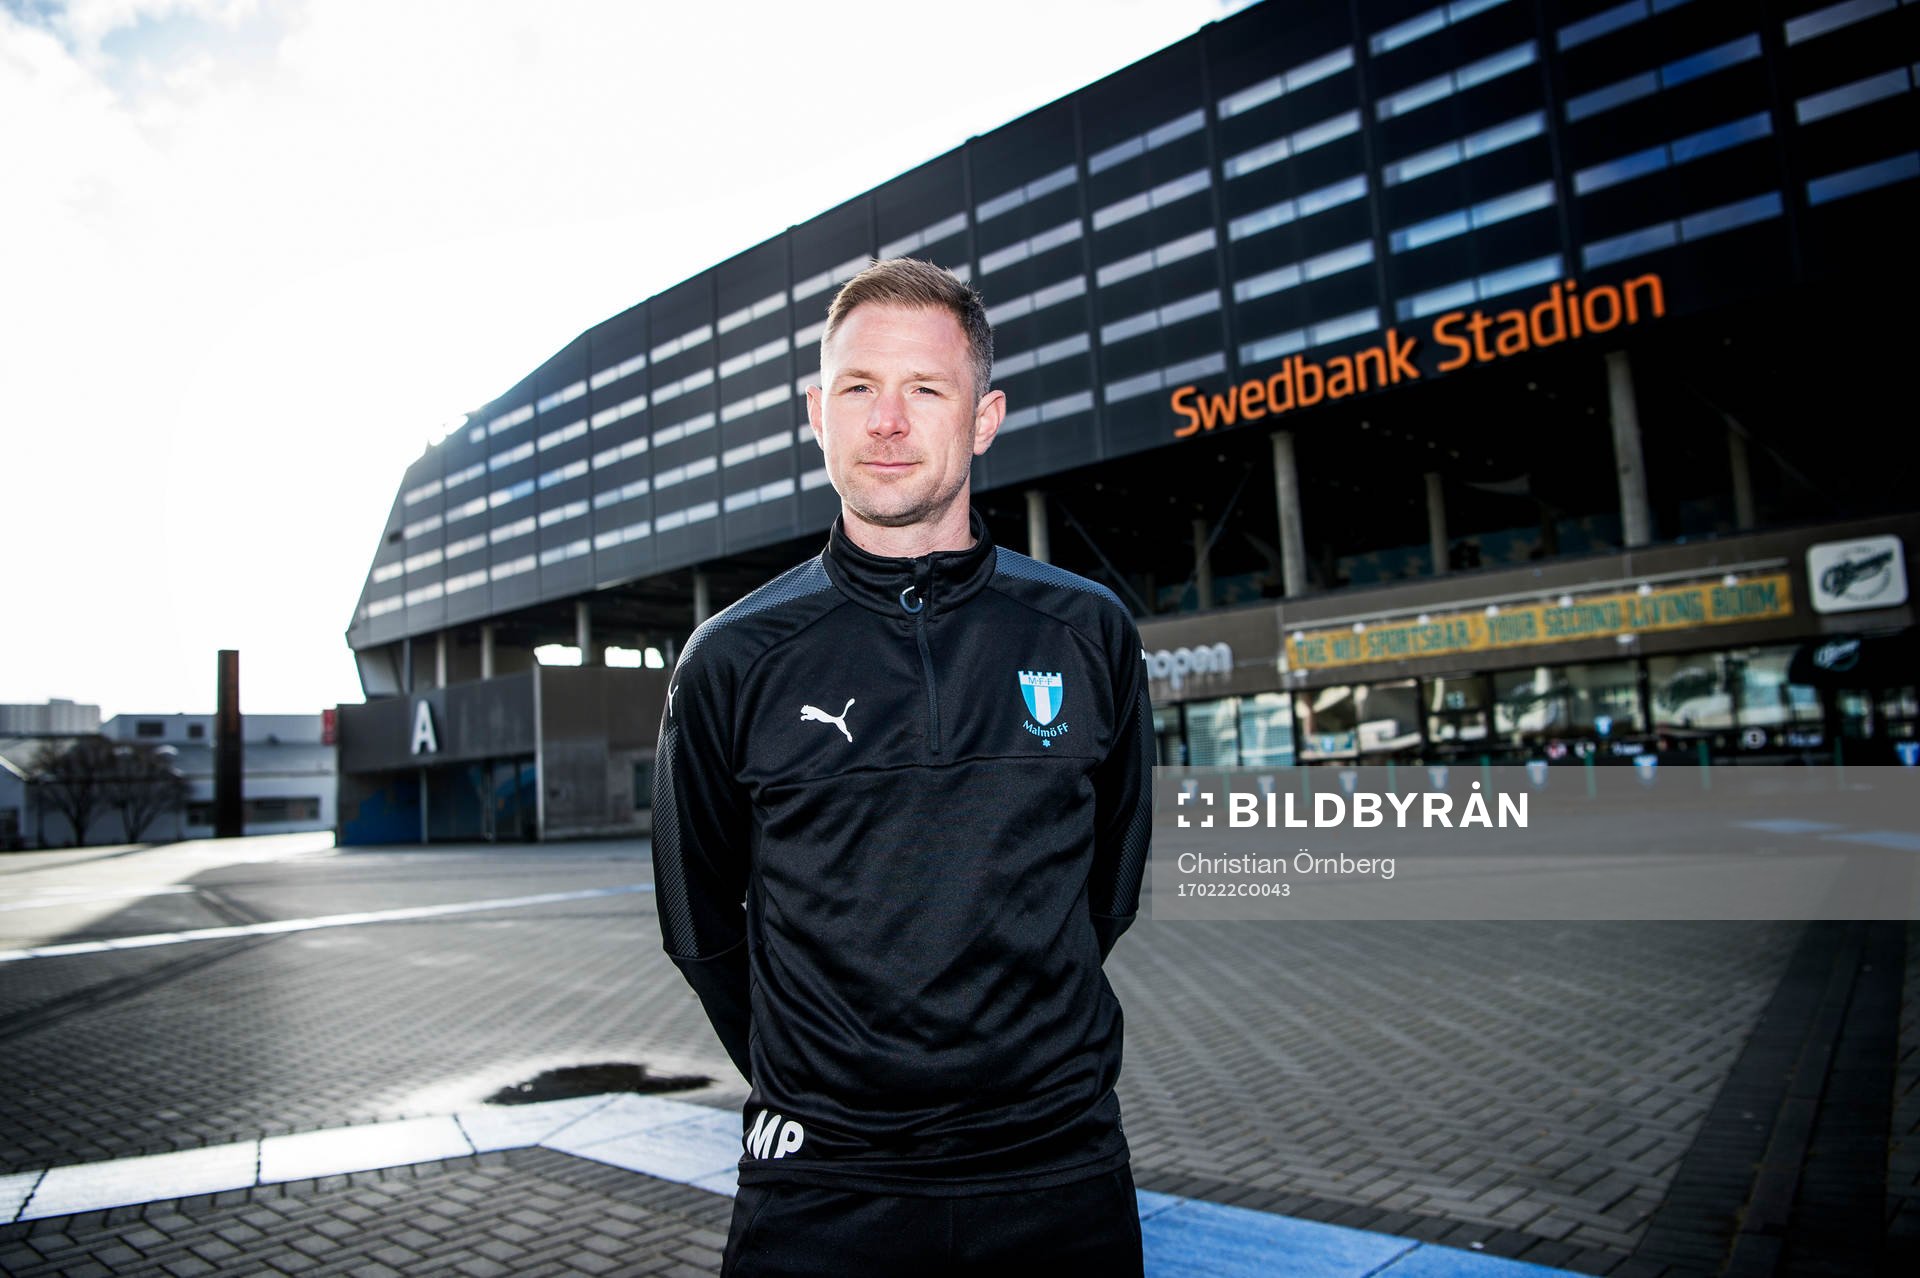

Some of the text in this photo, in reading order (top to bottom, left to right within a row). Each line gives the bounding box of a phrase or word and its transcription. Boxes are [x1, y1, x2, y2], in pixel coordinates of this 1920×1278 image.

[1170, 273, 1666, 438] Swedbank Stadion
[1711, 581, 1779, 617] ROOM
[411, 699, 437, 755] A
[1022, 720, 1070, 738] Malmö FF
[746, 1108, 804, 1160] MP
